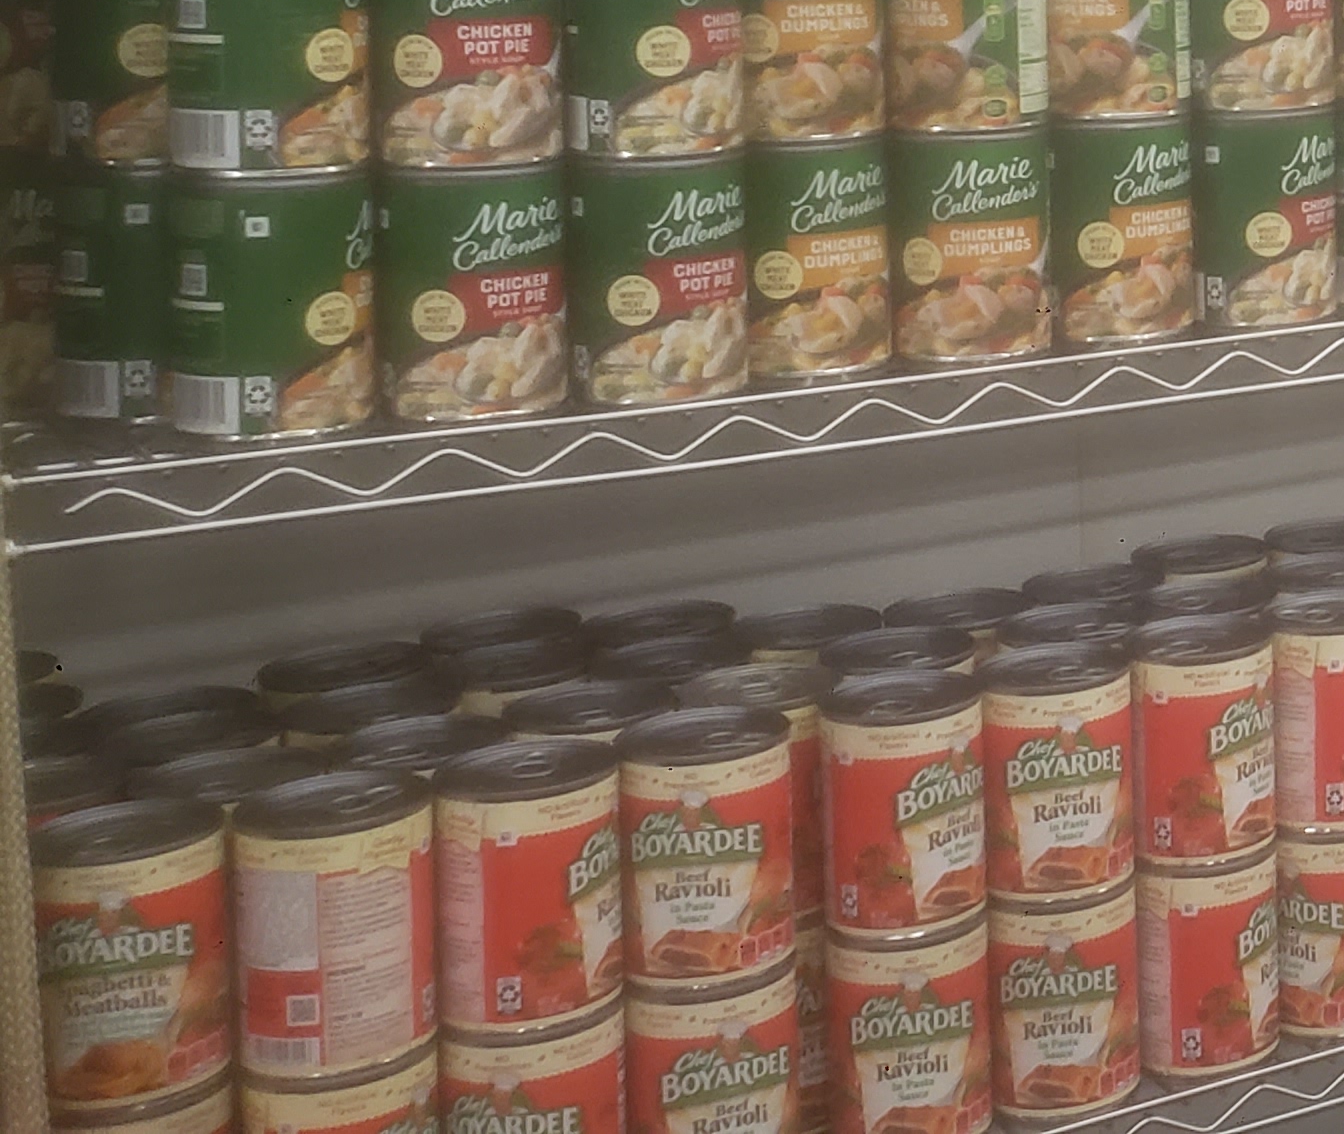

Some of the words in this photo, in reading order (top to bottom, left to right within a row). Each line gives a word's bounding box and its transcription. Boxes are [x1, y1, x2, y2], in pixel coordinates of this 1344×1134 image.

[457, 23, 533, 40] CHICKEN
[781, 15, 869, 33] DUMPLINGS
[464, 41, 496, 55] POT
[504, 38, 531, 54] PIE
[791, 165, 883, 206] Marie
[932, 157, 1033, 195] Marie
[811, 236, 869, 253] CHICKEN
[950, 227, 1014, 243] CHICKEN
[944, 238, 1032, 257] DUMPLINGS
[673, 257, 736, 278] CHICKEN
[480, 272, 549, 293] CHICKEN
[679, 277, 709, 293] POT
[713, 273, 734, 288] PIE
[487, 293, 519, 308] POT
[525, 289, 548, 304] PIE
[1017, 740, 1055, 759] Chef
[1007, 745, 1121, 788] BOYARDEE
[1054, 790, 1084, 804] Beef
[1034, 796, 1101, 823] Ravioli
[641, 812, 676, 832] Chef
[631, 823, 762, 862] BOYARDEE
[676, 870, 708, 883] Beef
[655, 876, 732, 902] Ravioli
[1001, 964, 1117, 1003] BOYARDEE
[851, 1001, 972, 1046] BOYARDEE
[1024, 1016, 1092, 1040] Ravioli
[674, 1052, 716, 1072] Chef
[897, 1048, 930, 1064] Beef
[661, 1045, 790, 1104] BOYARDEE
[877, 1056, 948, 1082] Ravioli
